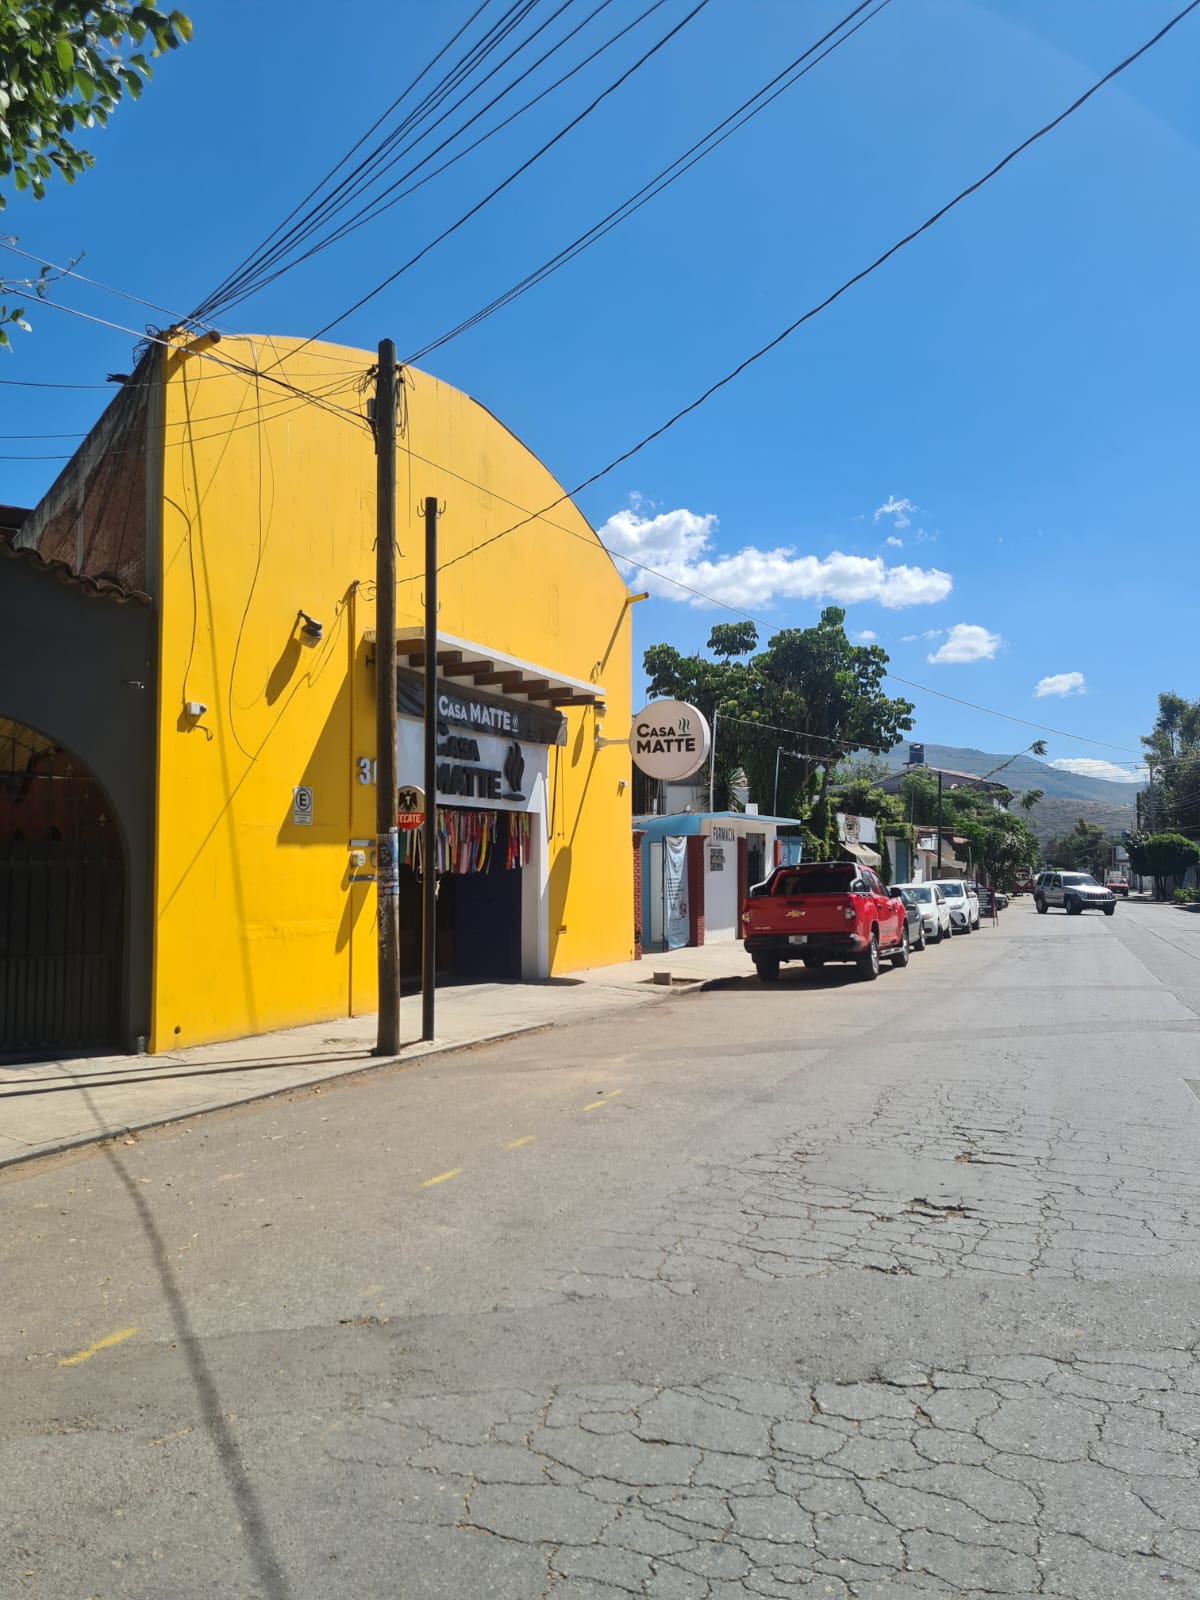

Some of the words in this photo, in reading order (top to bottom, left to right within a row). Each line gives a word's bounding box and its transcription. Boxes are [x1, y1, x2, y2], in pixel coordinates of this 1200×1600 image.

[438, 695, 468, 720] CASA
[469, 702, 511, 731] MATTE
[636, 723, 676, 738] CASA
[636, 737, 696, 754] MATTE
[359, 758, 378, 785] 3
[436, 763, 502, 800] MATTE
[299, 793, 307, 807] E
[713, 826, 736, 842] FARMACIA
